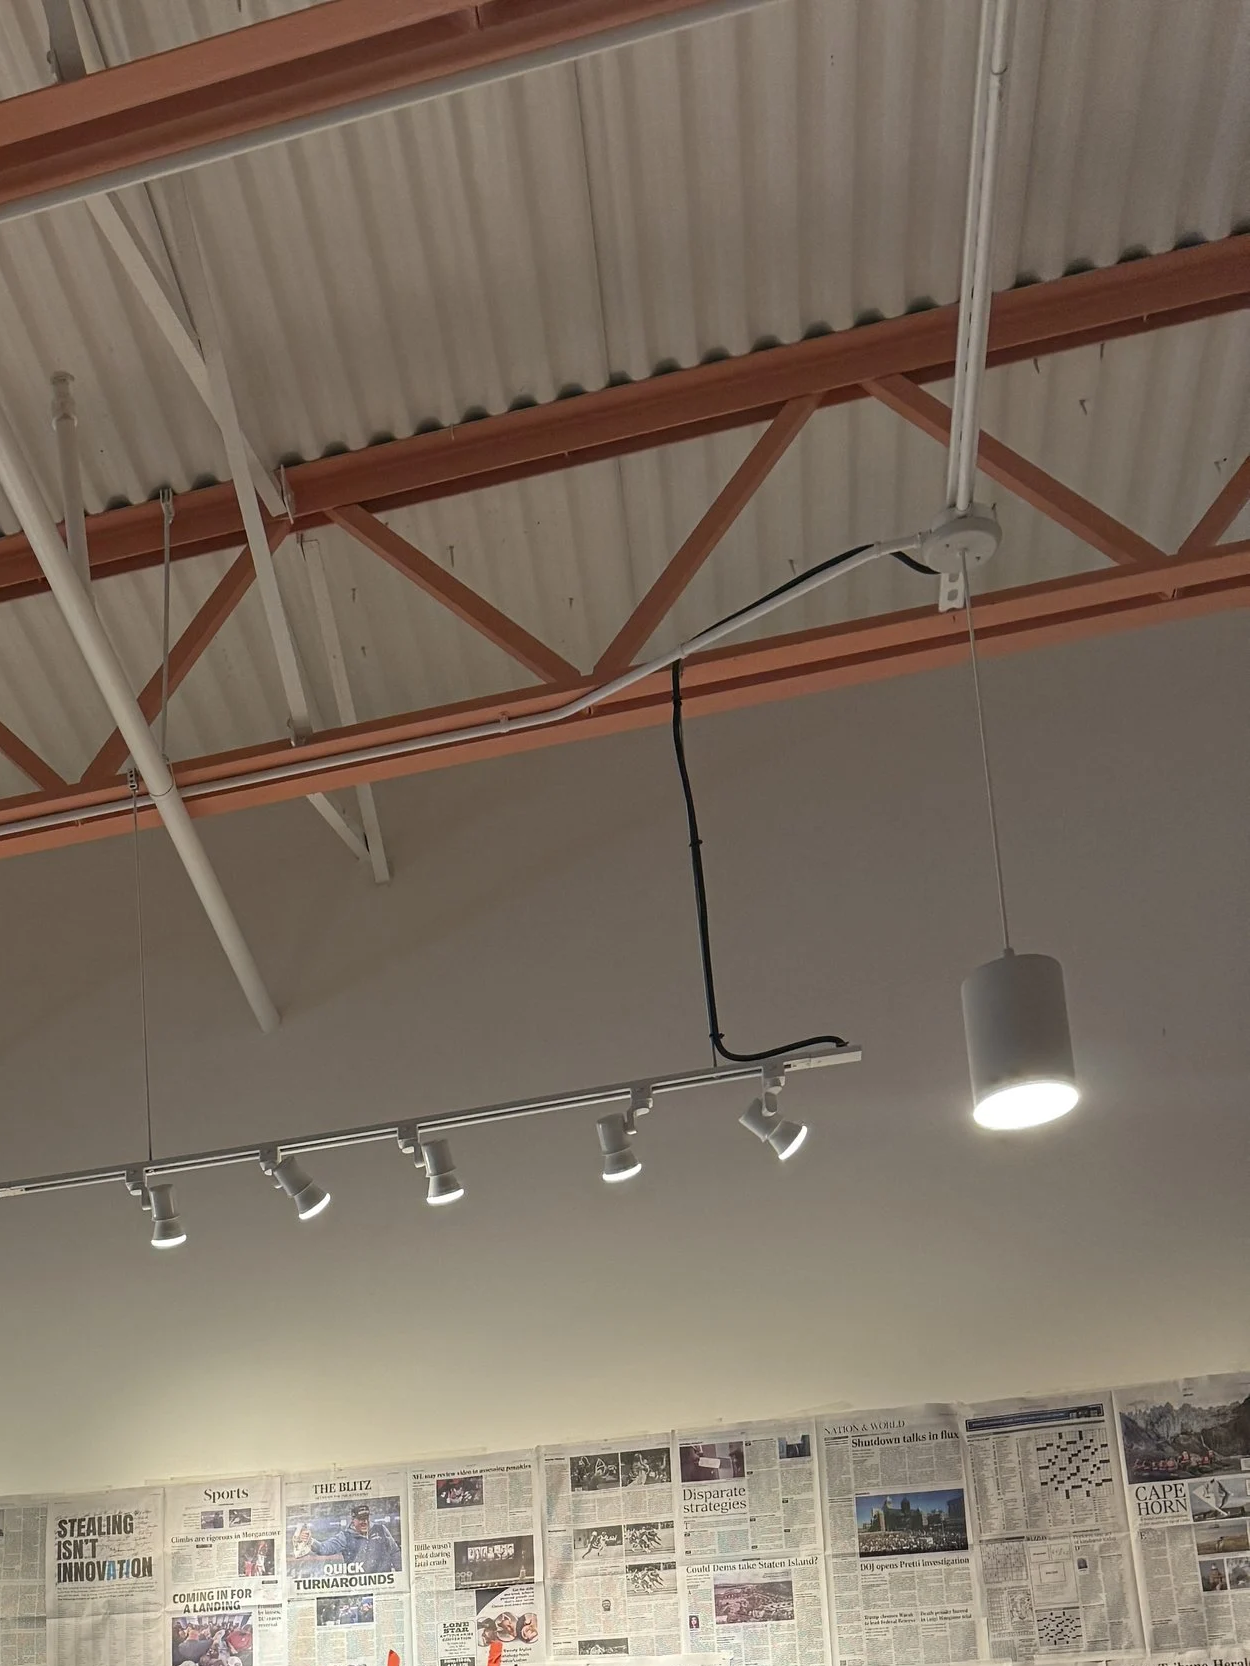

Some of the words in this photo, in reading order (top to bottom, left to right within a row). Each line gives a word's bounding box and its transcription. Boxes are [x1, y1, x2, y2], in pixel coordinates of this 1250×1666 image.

[852, 1434, 900, 1448] Shutdown
[902, 1433, 925, 1444] talks
[928, 1432, 938, 1441] in
[941, 1430, 959, 1441] flux
[312, 1482, 336, 1494] THE
[338, 1479, 371, 1493] BLITZ
[683, 1486, 746, 1501] Disparate
[1135, 1483, 1186, 1501] CAPE
[204, 1487, 249, 1502] Sports
[683, 1499, 747, 1514] strategies
[1137, 1499, 1188, 1516] HORN
[57, 1514, 134, 1539] STEALING
[57, 1538, 99, 1561] ISN'T
[57, 1556, 153, 1584] INNOVATION
[324, 1561, 365, 1574] QUICK
[860, 1563, 874, 1572] DOJ
[876, 1562, 898, 1572] opens
[922, 1557, 969, 1569] investigation
[294, 1573, 394, 1590] TURNAROUNDS
[172, 1591, 213, 1604] COMING
[216, 1591, 227, 1602] IN
[230, 1589, 252, 1601] FOR
[183, 1603, 191, 1614] A
[192, 1601, 241, 1614] LANDING
